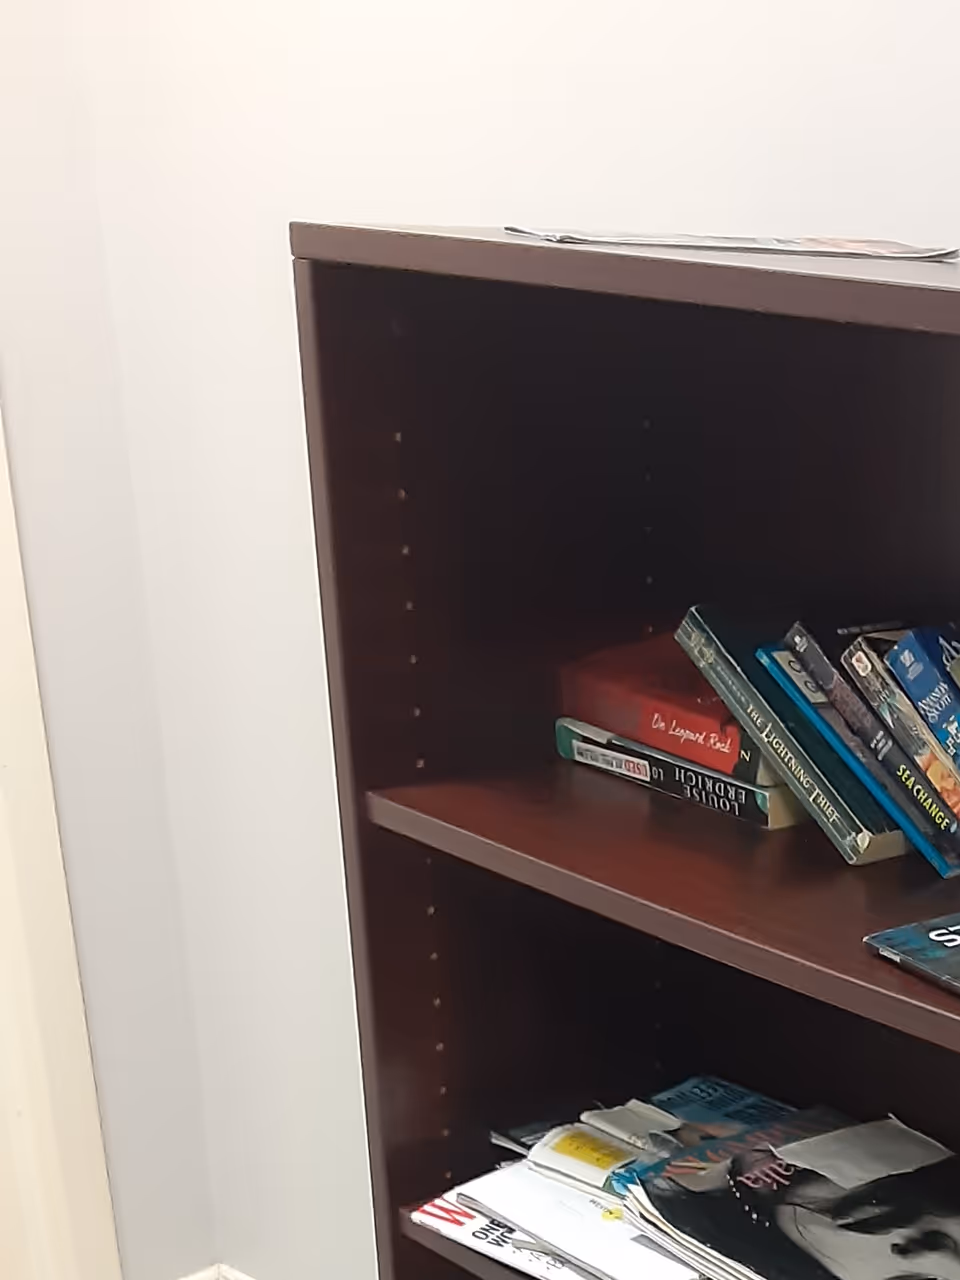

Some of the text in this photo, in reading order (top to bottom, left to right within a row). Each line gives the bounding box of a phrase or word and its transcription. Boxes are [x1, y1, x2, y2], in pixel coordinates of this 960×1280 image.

[676, 767, 746, 803] ERDRICH
[747, 704, 841, 823] THE LIGHTNING THIEF
[684, 785, 739, 815] LOUISE
[896, 764, 950, 830] SEA CHANGE
